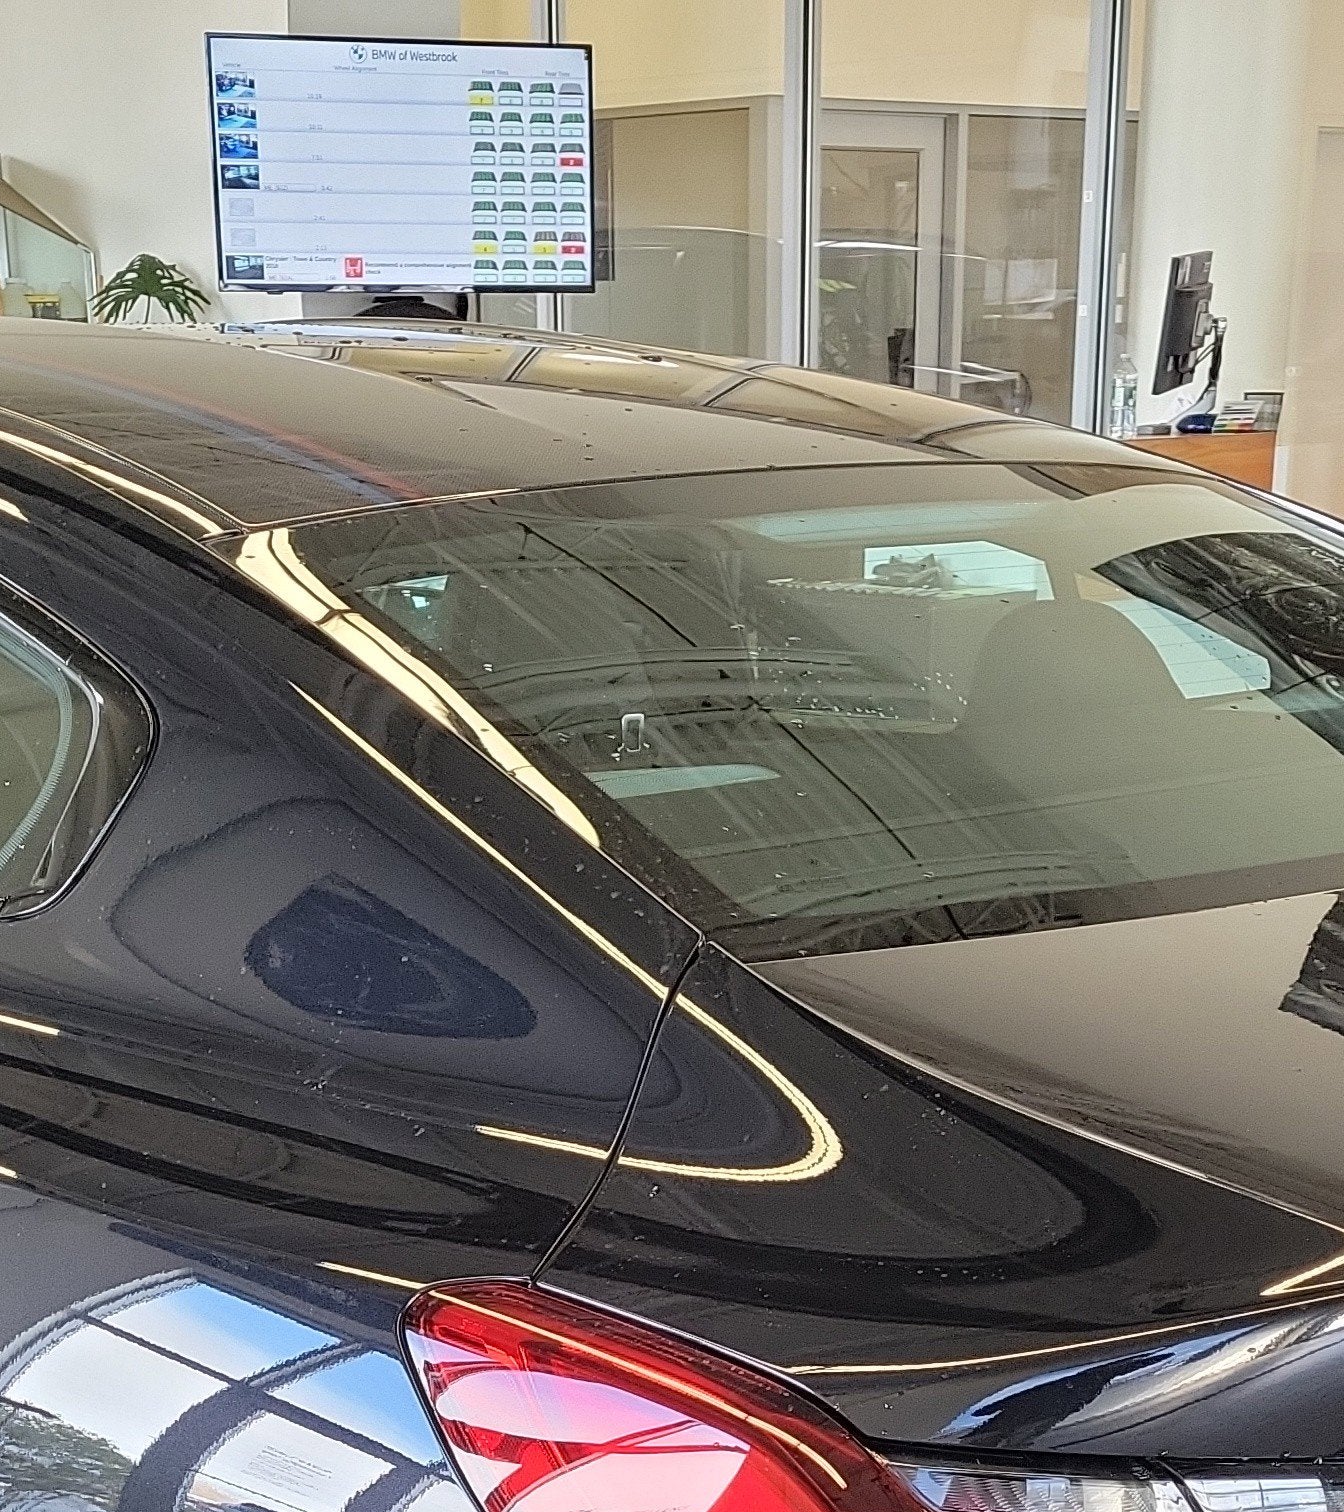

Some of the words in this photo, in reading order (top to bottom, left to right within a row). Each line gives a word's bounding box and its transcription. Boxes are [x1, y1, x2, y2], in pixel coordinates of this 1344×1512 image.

[371, 49, 397, 60] BMW
[398, 50, 407, 61] of
[409, 51, 458, 62] Westbrook
